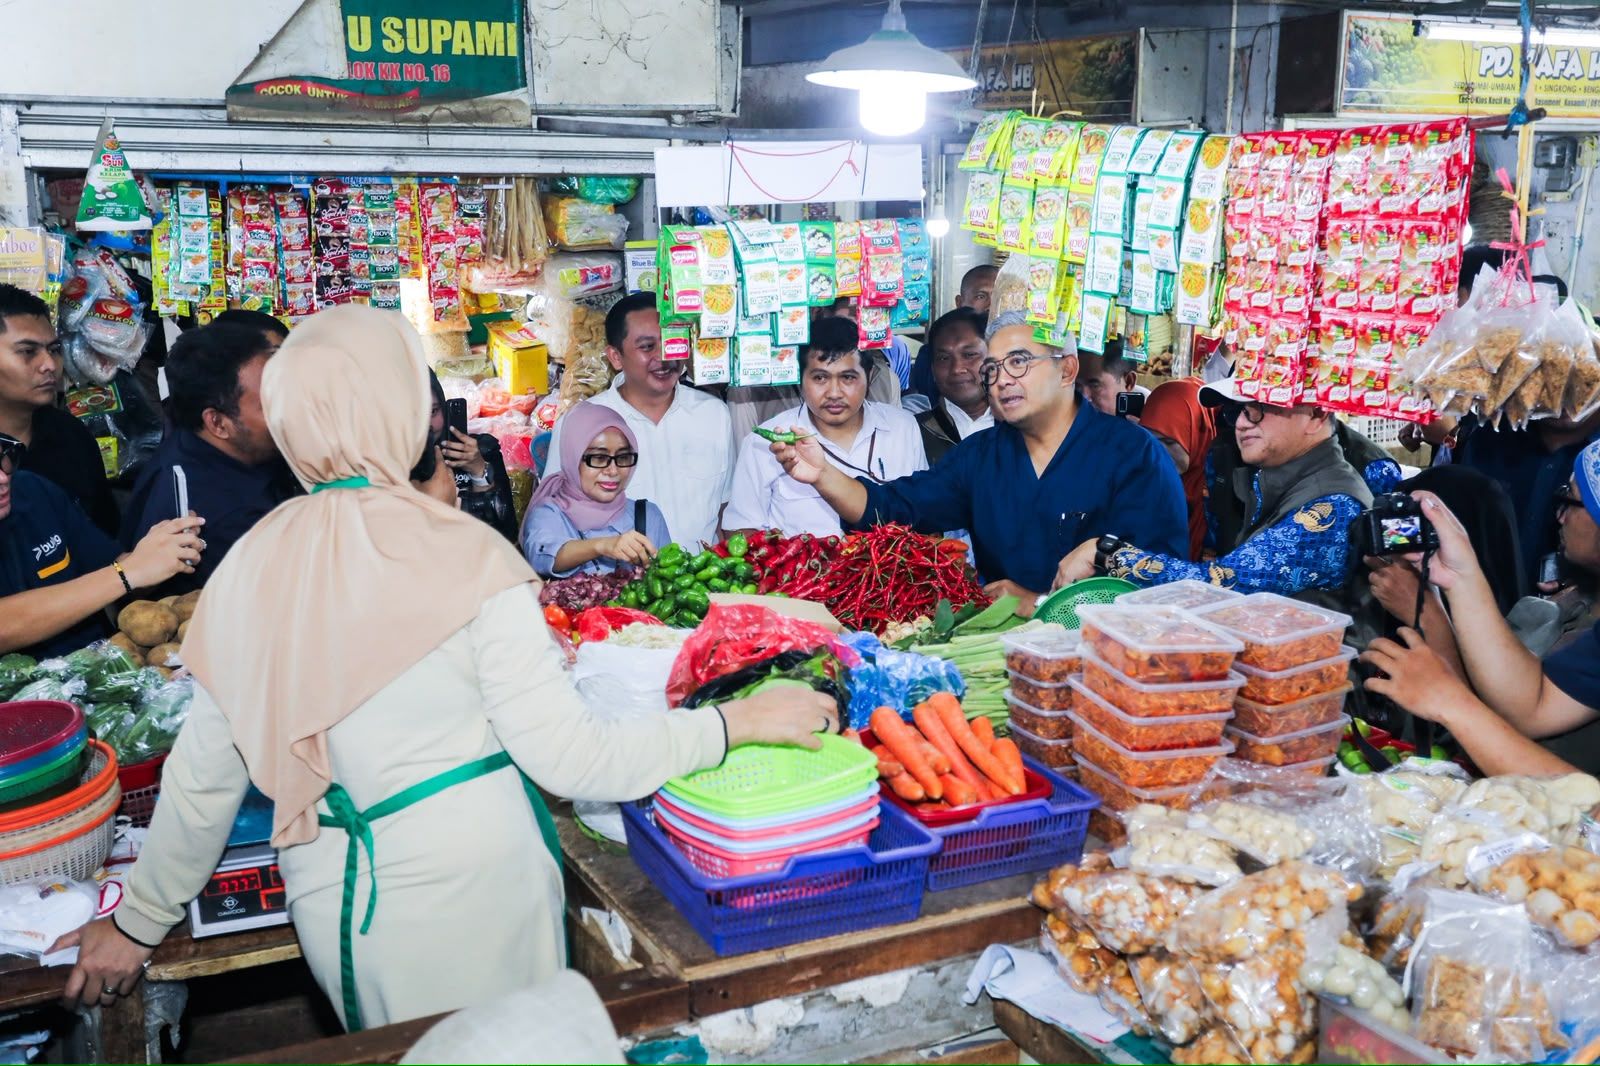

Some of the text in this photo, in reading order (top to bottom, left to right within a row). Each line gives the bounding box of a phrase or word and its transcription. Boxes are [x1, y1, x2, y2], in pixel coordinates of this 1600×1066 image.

[347, 15, 517, 57] U SUPAMI
[1479, 45, 1513, 77] PD.
[403, 63, 429, 82] NO.
[431, 64, 450, 82] 16
[975, 62, 1035, 91] AFA HB
[872, 236, 893, 247] SAORI
[877, 281, 898, 292] SAORI
[86, 312, 136, 326] MANGKOK
[867, 330, 886, 341] SAORI
[40, 534, 62, 553] bug
